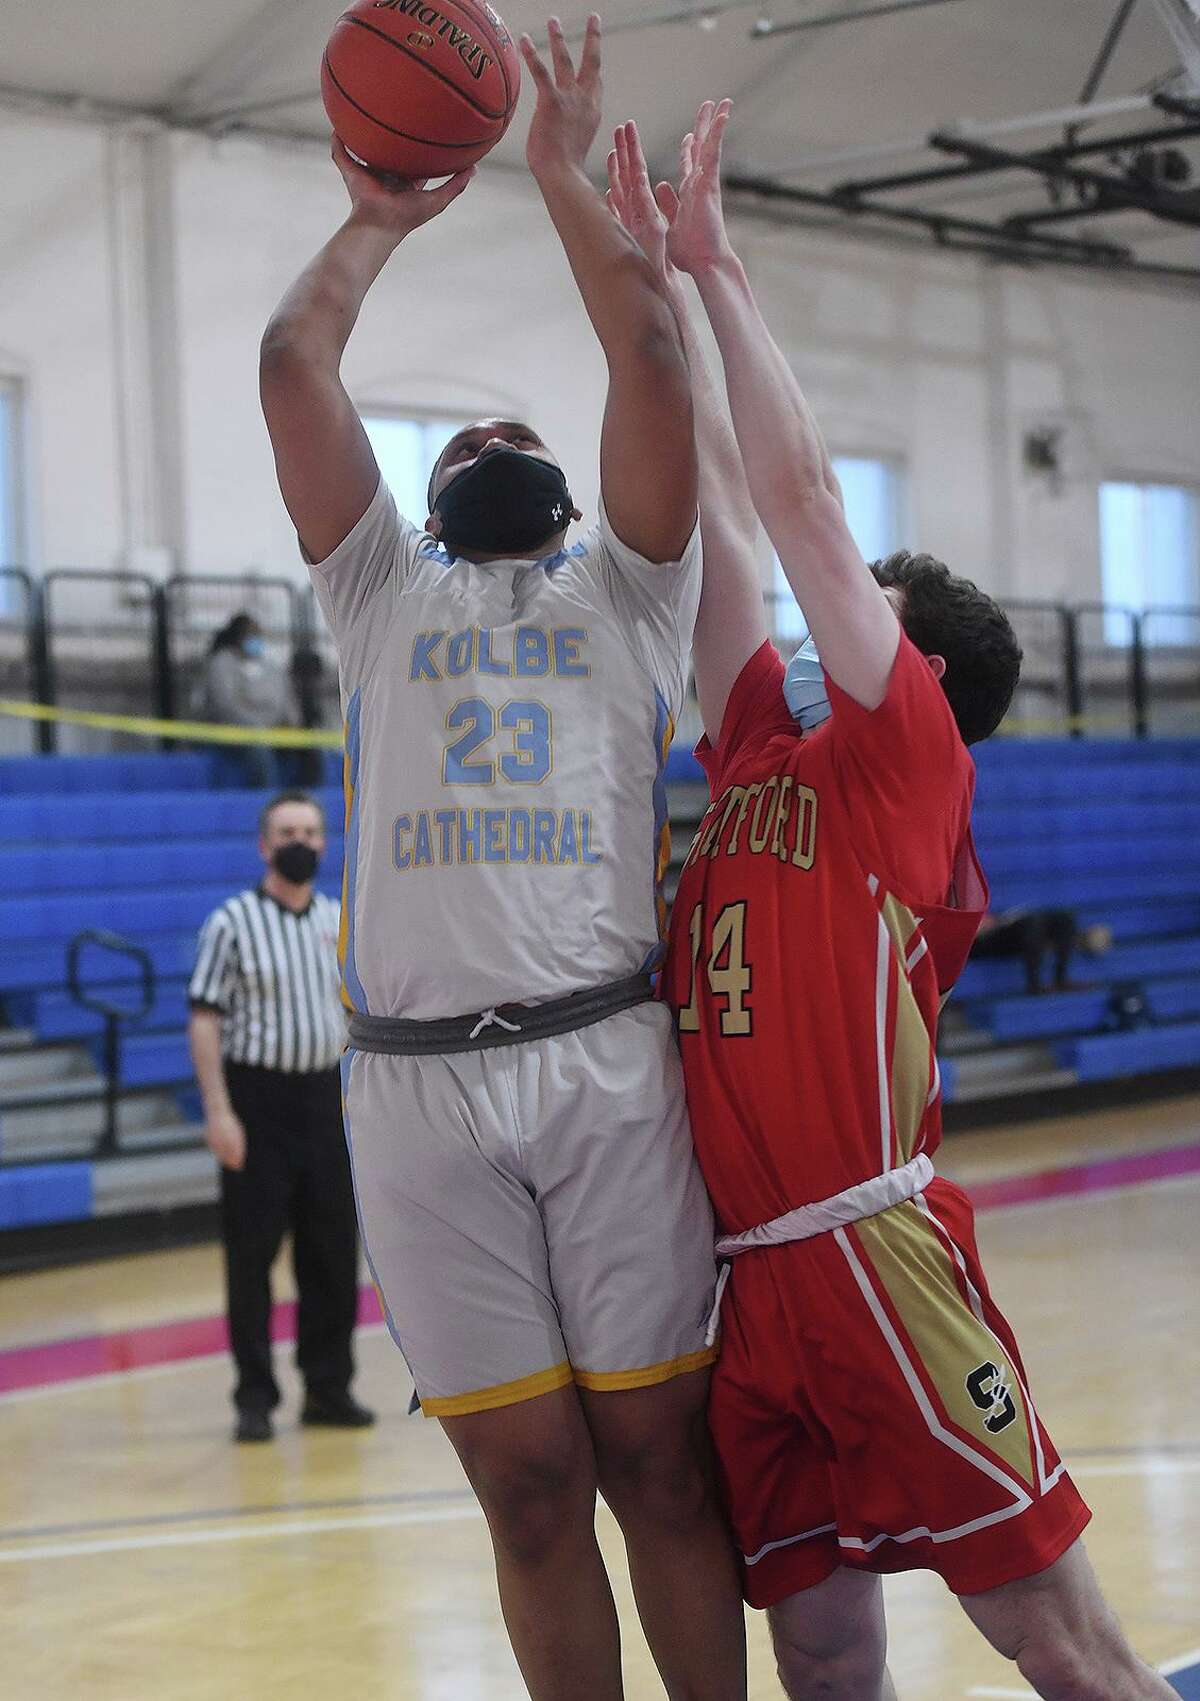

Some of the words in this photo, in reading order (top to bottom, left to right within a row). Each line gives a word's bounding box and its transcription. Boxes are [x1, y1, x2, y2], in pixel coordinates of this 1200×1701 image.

[408, 624, 592, 683] KOLBE
[441, 696, 552, 787] 23
[391, 807, 601, 871] CATHEDRAL
[678, 900, 753, 1037] 14
